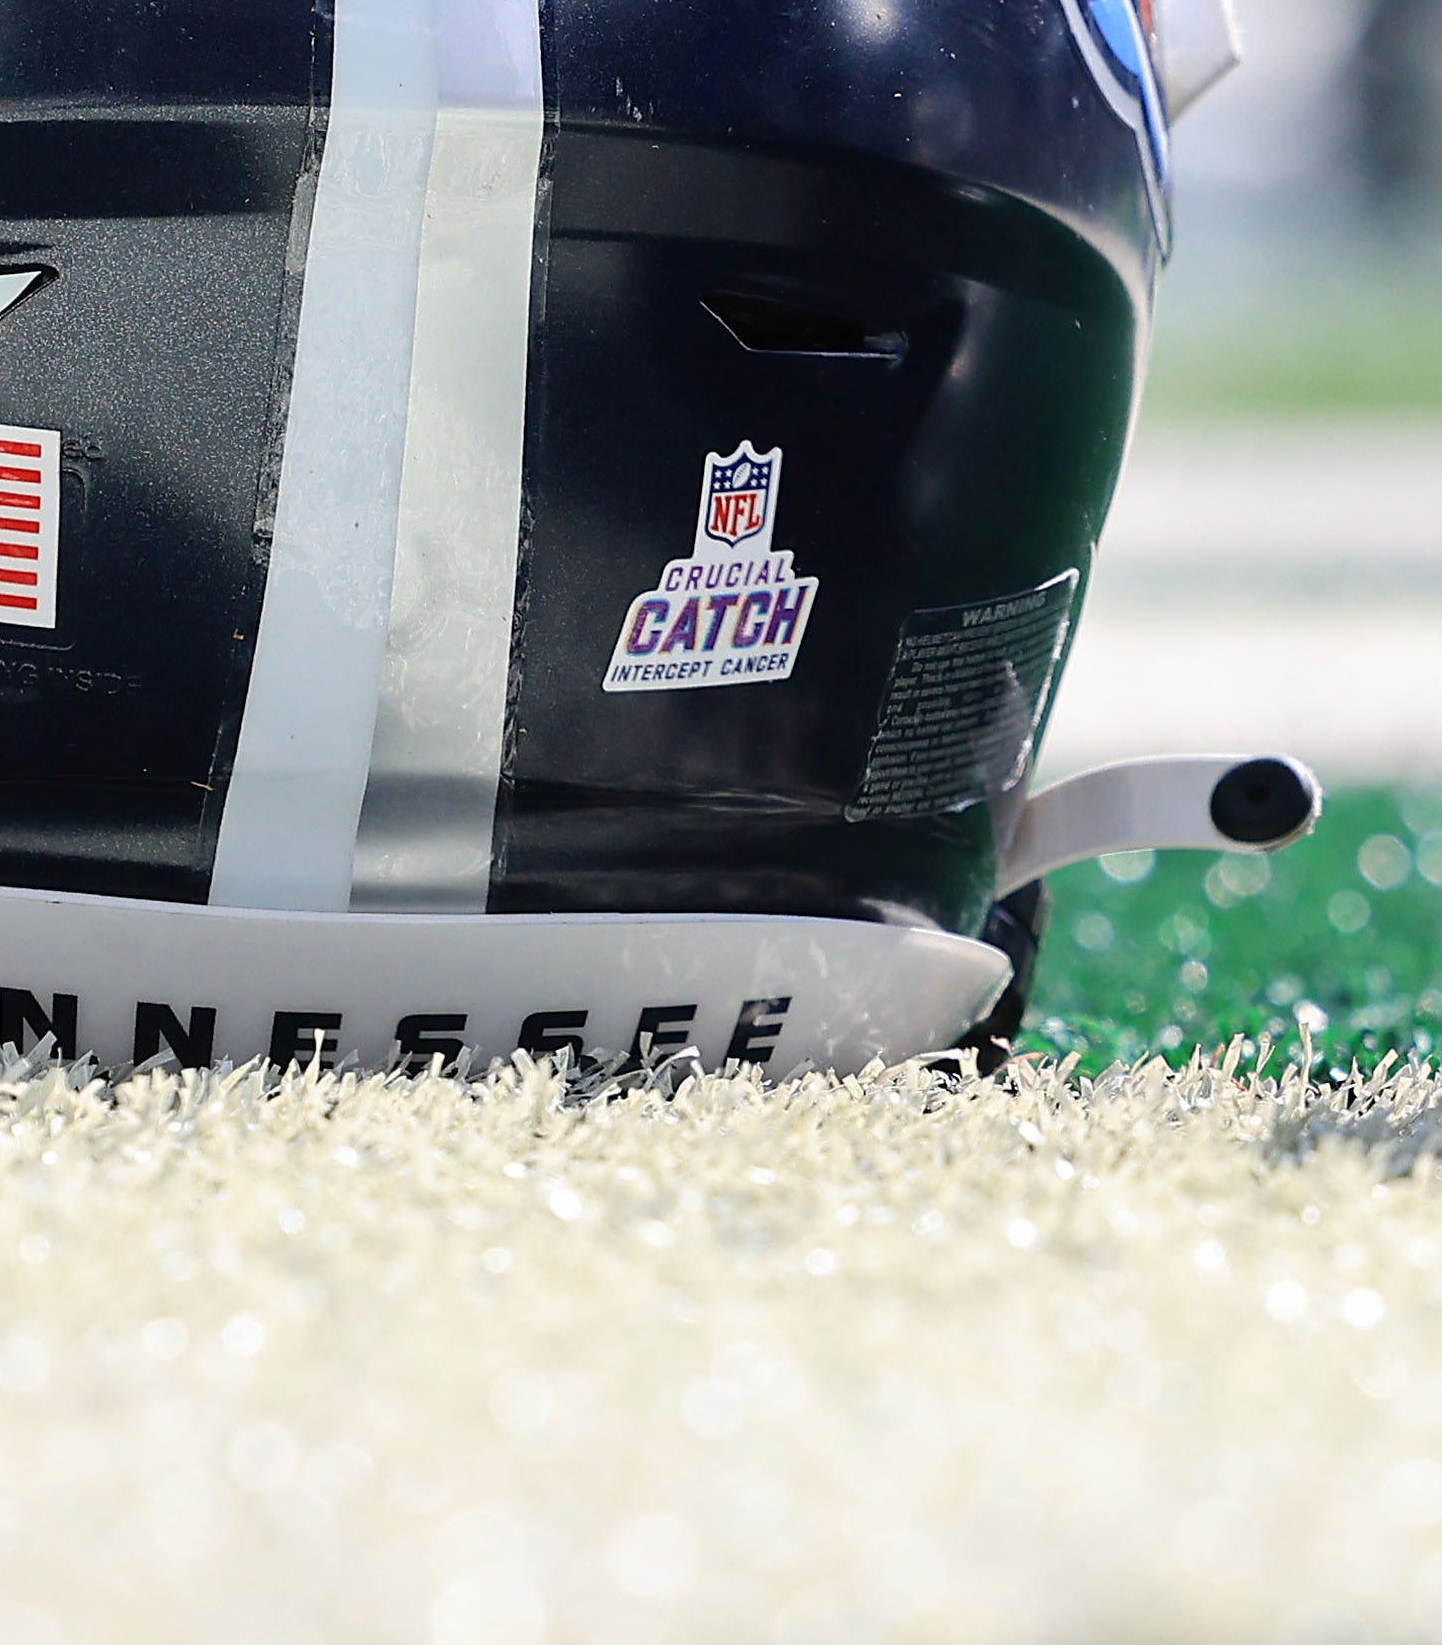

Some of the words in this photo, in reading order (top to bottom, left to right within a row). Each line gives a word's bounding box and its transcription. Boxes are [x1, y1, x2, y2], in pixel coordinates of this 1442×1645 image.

[710, 493, 761, 537] NFL
[665, 558, 787, 591] CRUCIAL
[626, 585, 811, 655] CATCH
[961, 591, 1047, 627] WARNING
[611, 661, 713, 682] INTERCEPT
[720, 653, 790, 675] CANCER
